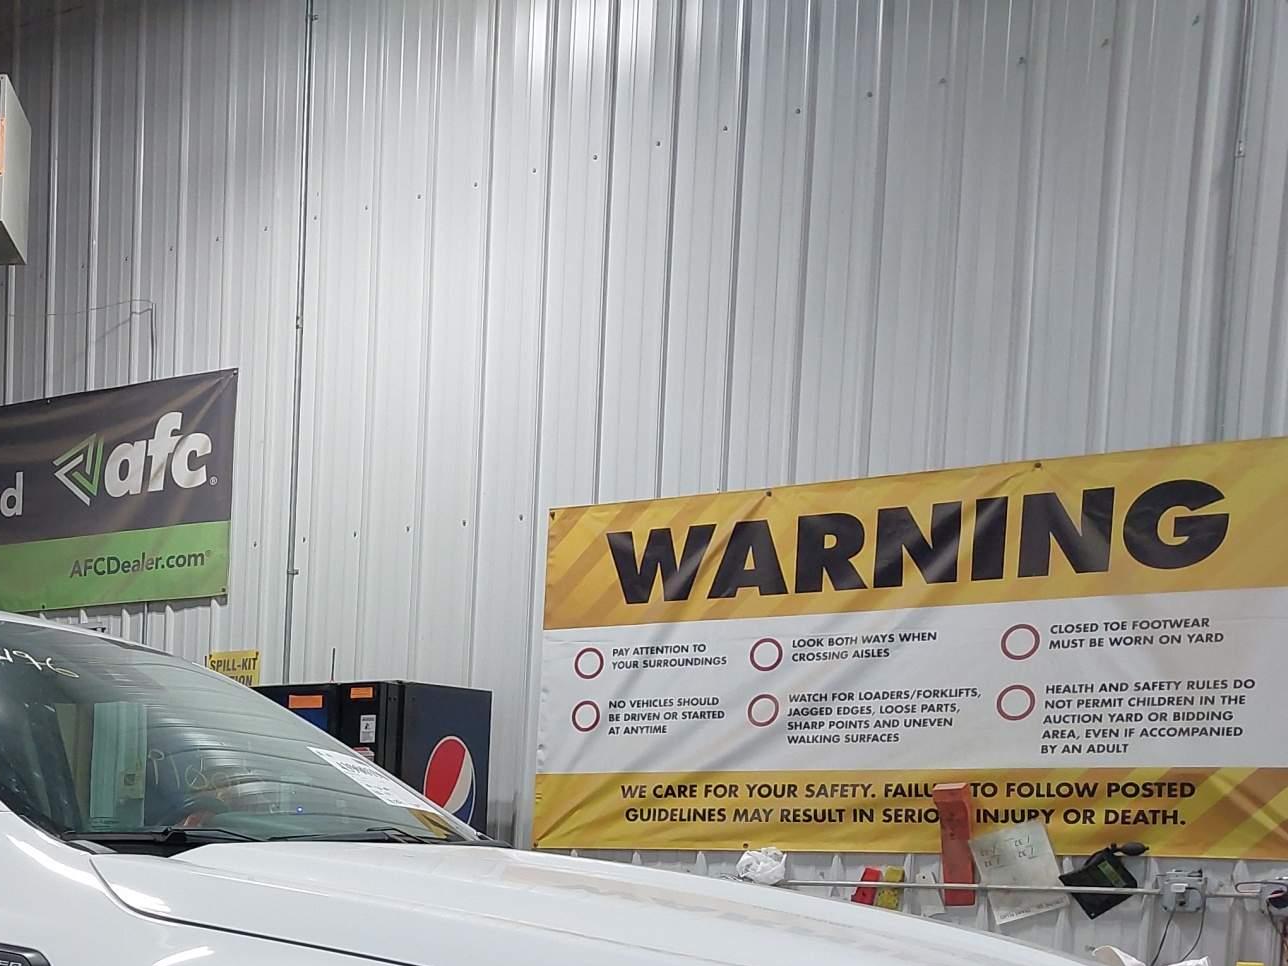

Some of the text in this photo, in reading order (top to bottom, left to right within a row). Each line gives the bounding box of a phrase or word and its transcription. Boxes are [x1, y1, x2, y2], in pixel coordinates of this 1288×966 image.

[104, 411, 212, 498] afc
[605, 478, 1230, 606] WARNING
[1050, 617, 1210, 635] CLOSED TOE FOOTWEAR
[792, 631, 937, 648] LOOK BOTH WAYS WHEN
[1048, 632, 1224, 650] MUST BE WORN ON YARD
[612, 643, 707, 657] PAY ATTENTION TO
[792, 648, 890, 662] CROSSING AISLES
[210, 657, 257, 672] SPILL-KIT
[612, 656, 727, 670] YOUR SURROUNDINGS
[1045, 678, 1256, 695] HEALTH AND SAFETY RULES DO
[788, 687, 982, 703] WATCH FOR LOADERS/FORKLIFTS,
[1044, 695, 1246, 709] NOT PERMIT CHILDREN IN THE
[608, 696, 720, 709] NO VEHICLES SHOULD
[608, 710, 725, 722] BE DRIVEN OR STARTED
[787, 703, 961, 717] JAGGED EDGES, LOOSE PARTS,
[787, 717, 953, 731] SHARP POINTS AND UNEVEN
[1043, 711, 1234, 725] AUCTION YARD OR BIDDING
[608, 725, 667, 735] AT ANYTIME
[1042, 726, 1243, 740] AREA, EVEN IF ACCOMPANIED
[787, 733, 900, 745] WALKING SURFACES
[1040, 743, 1129, 755] BY AN ADULT
[620, 782, 1196, 799] WE CARE FOR YOUR SAFETY. FAILU TO FOLLOW POSTED
[624, 807, 1187, 826] GUIDELINES MAY RESULT IN SERIO INJURY OR DEATH.
